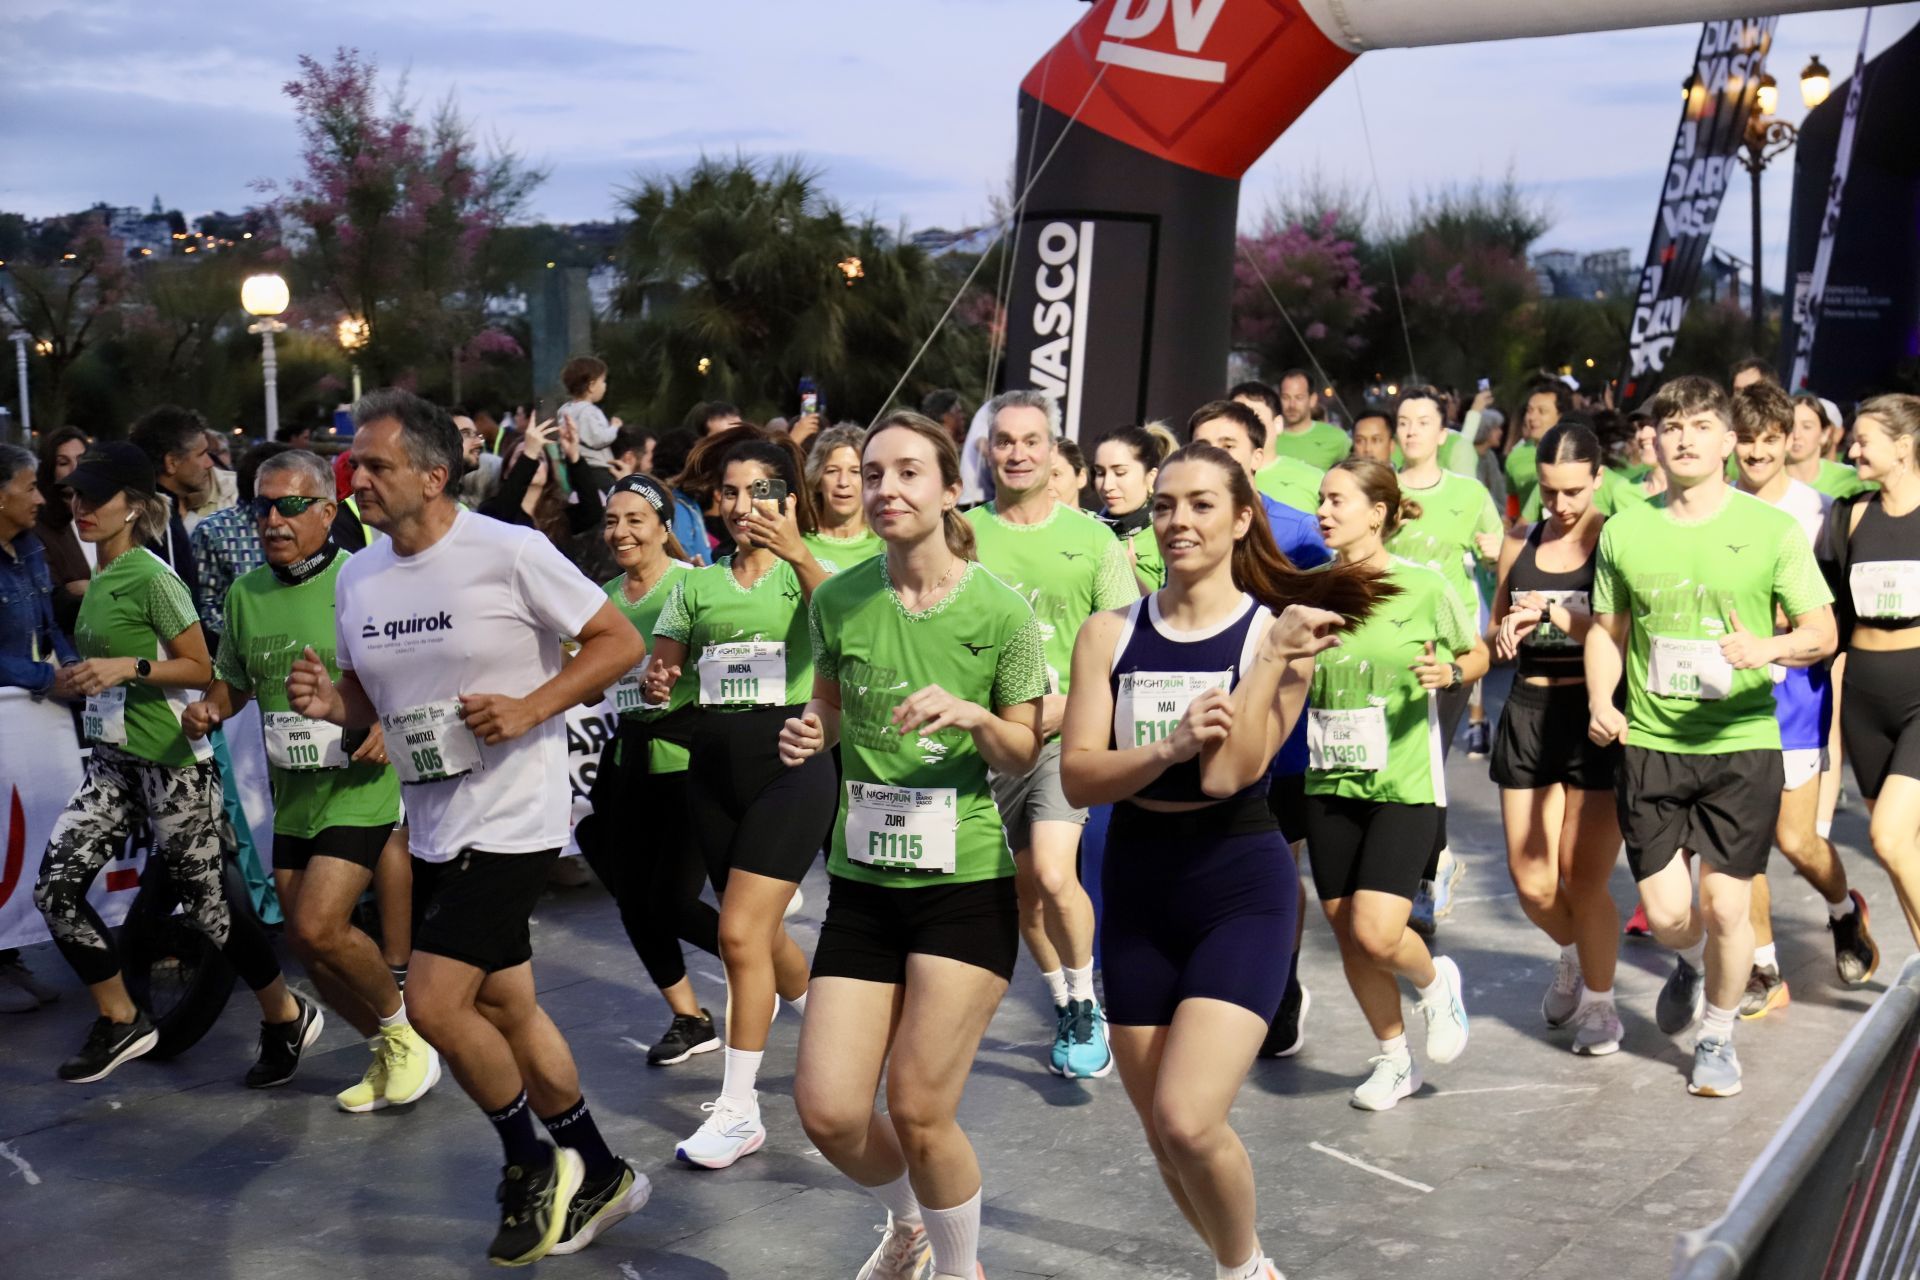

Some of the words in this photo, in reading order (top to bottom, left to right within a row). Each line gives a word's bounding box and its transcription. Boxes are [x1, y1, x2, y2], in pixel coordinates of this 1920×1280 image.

[1104, 0, 1226, 53] DV
[1029, 221, 1078, 400] VASCO
[383, 610, 453, 640] quirok
[727, 664, 752, 674] JIMENA
[720, 677, 759, 698] F1111
[1132, 679, 1184, 690] NIGHTRUN
[1668, 673, 1701, 692] 460
[1157, 701, 1176, 713] MAI
[289, 731, 311, 741] PEPITO
[405, 730, 436, 746] MARTXEL
[286, 744, 319, 764] 1110
[411, 746, 443, 774] 805
[1322, 744, 1367, 763] F1350
[866, 790, 911, 804] NIGHTRUN
[944, 795, 952, 809] 4
[884, 814, 906, 827] ZURI
[868, 830, 923, 860] F1115
